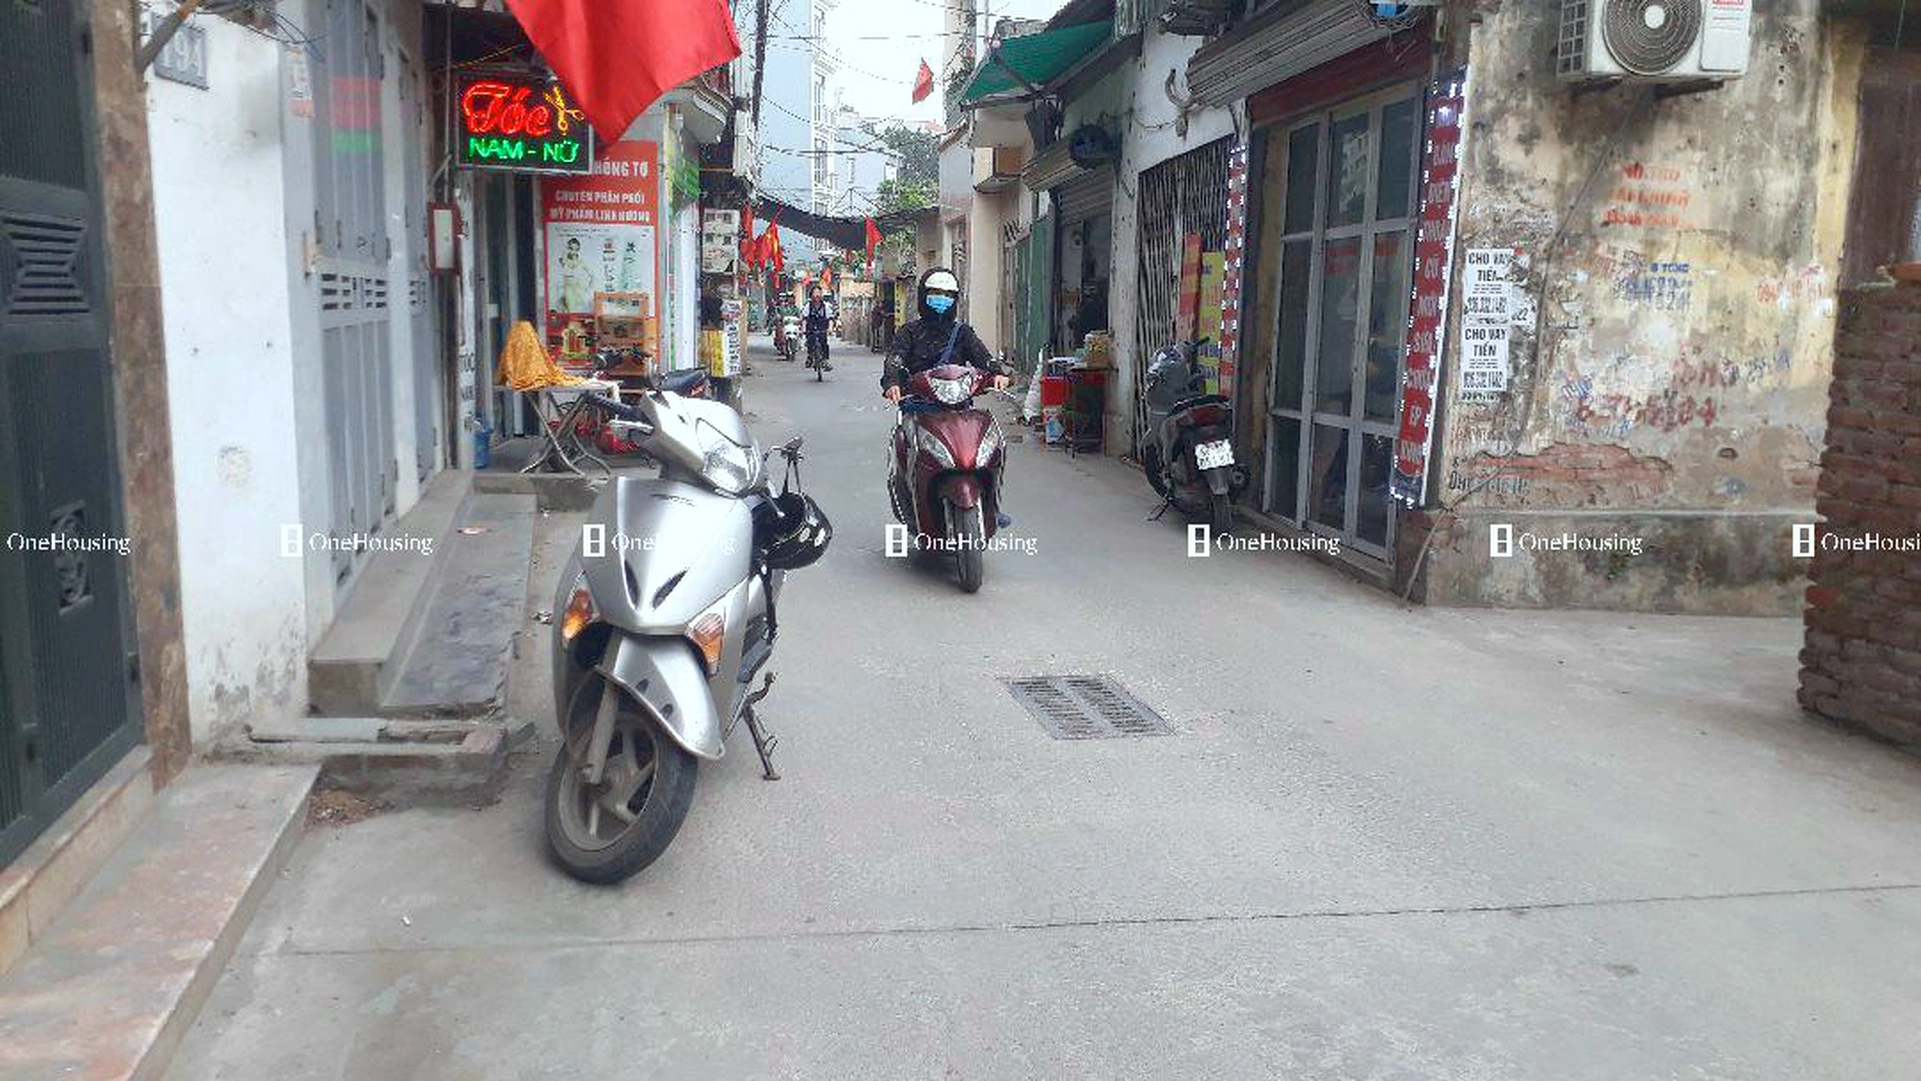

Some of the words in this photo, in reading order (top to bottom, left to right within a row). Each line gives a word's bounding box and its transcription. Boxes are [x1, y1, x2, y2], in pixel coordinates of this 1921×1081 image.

[468, 138, 524, 160] NAM
[1468, 252, 1490, 265] CHO
[1465, 329, 1486, 340] CHO
[1488, 329, 1506, 340] VAY
